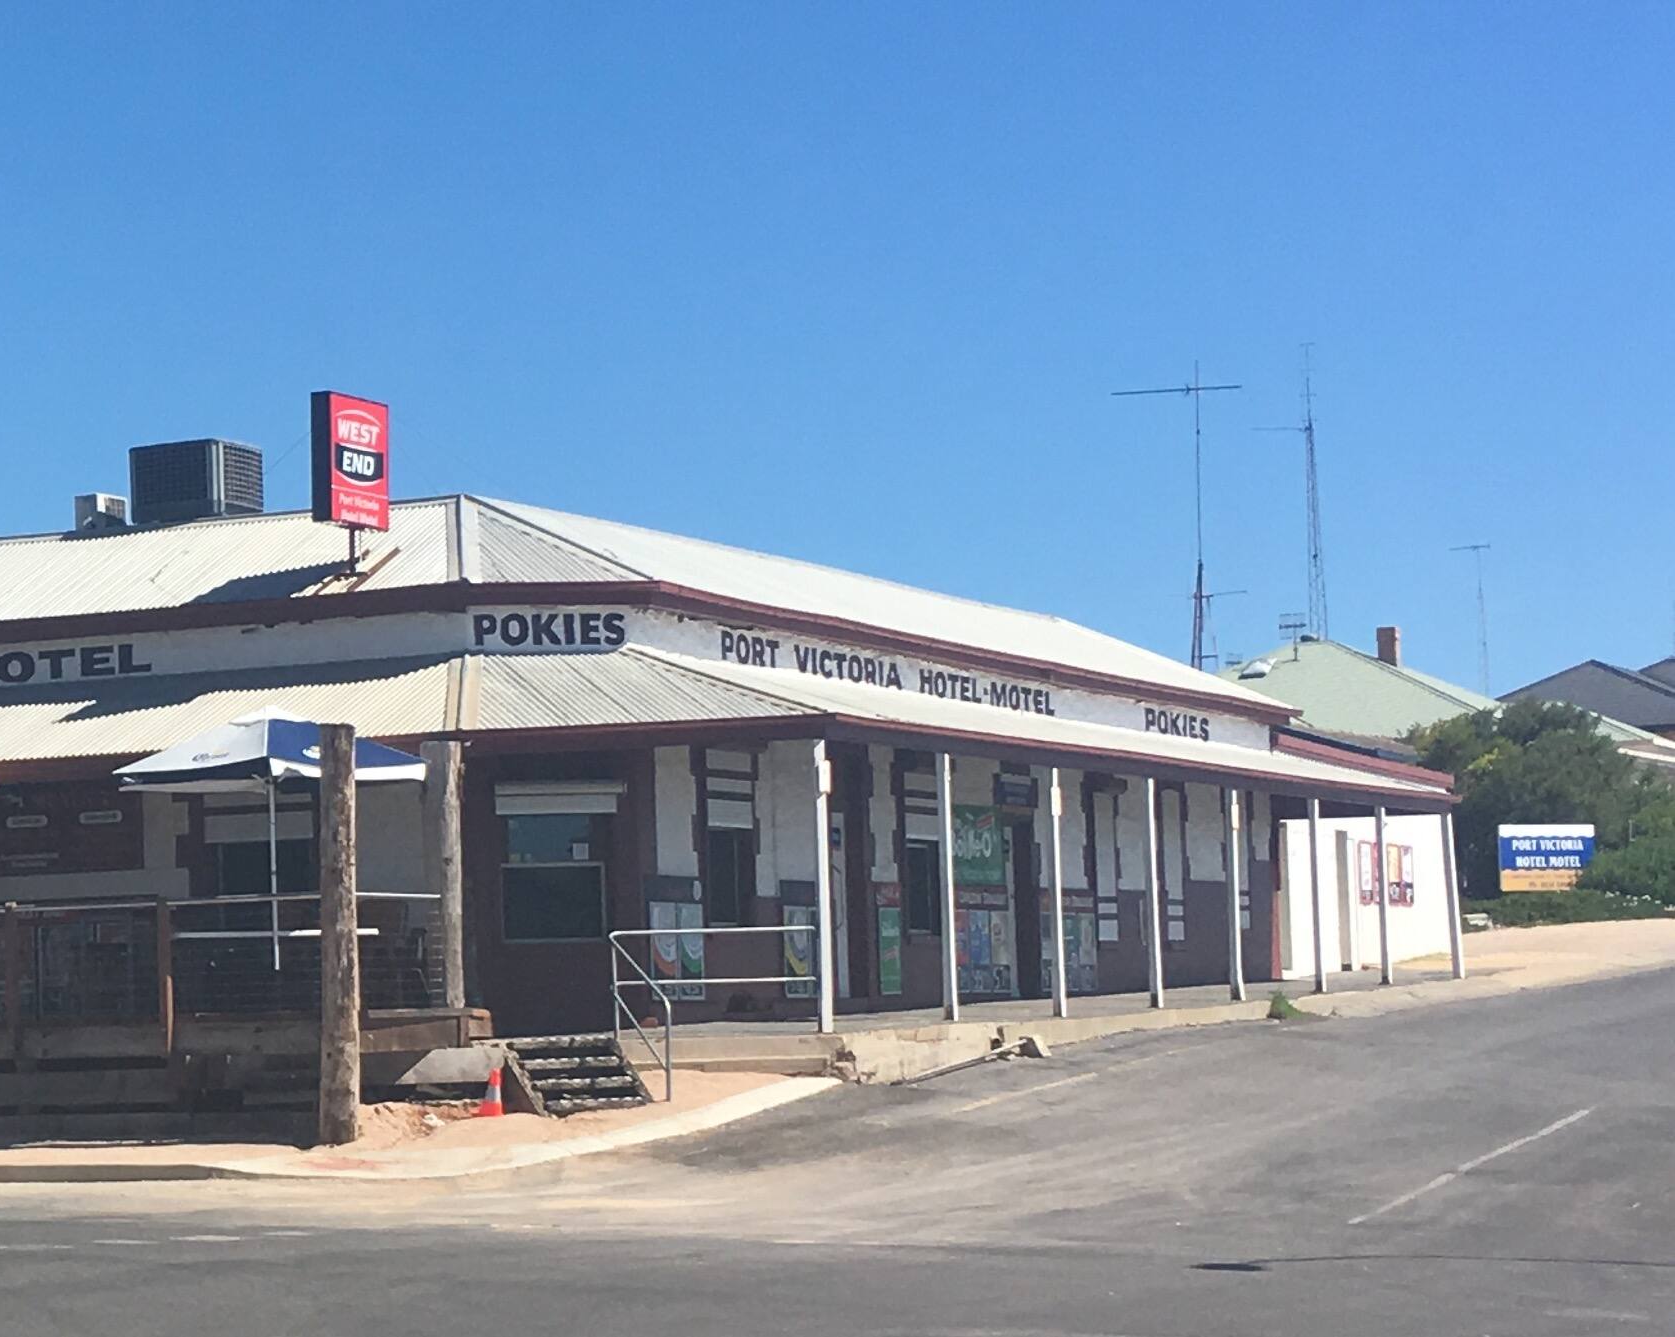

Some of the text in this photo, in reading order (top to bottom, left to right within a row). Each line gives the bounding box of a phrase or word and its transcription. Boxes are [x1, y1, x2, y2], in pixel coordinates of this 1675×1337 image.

[337, 418, 381, 446] WEST
[342, 450, 375, 477] END
[472, 612, 626, 647] POKIES
[720, 630, 780, 668] PORT
[794, 643, 903, 691] VICTORIA
[1144, 707, 1210, 742] POKIES
[1511, 839, 1584, 851] PORT VICTORIA
[1515, 855, 1582, 867] HOTEL MOTEL
